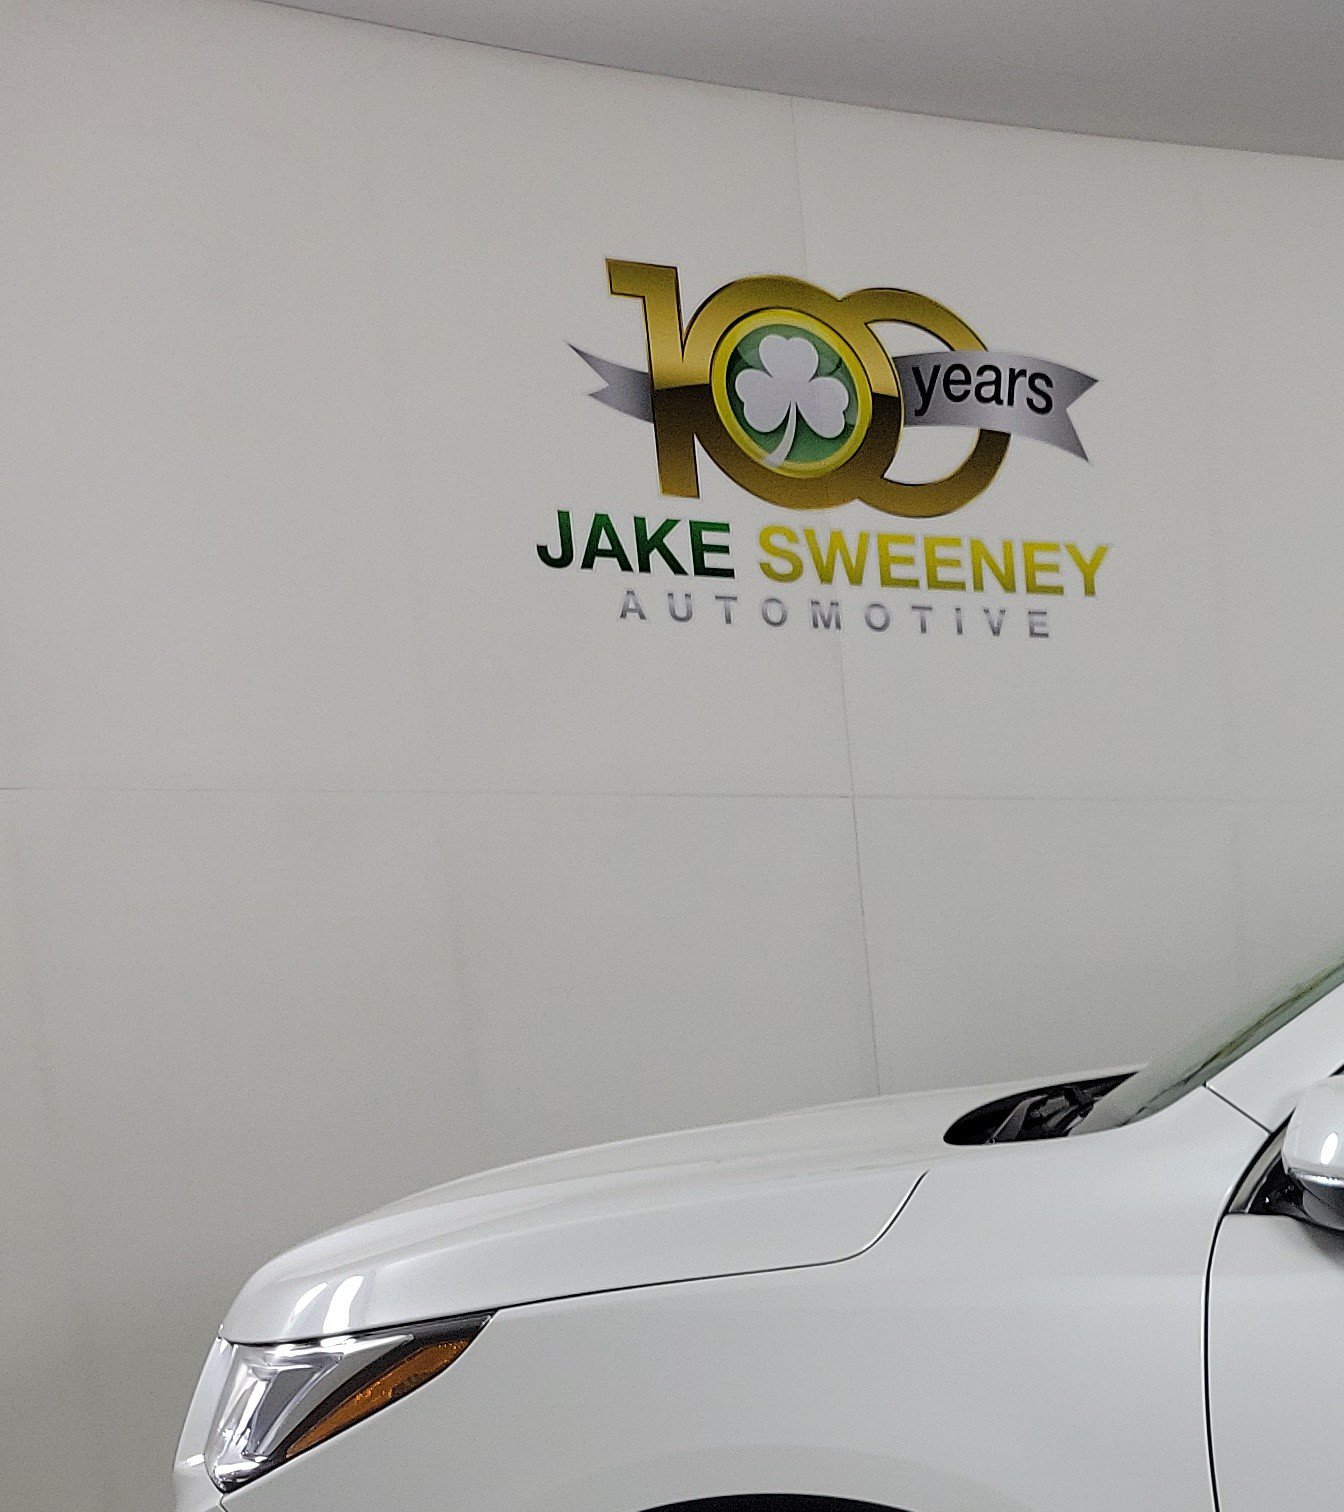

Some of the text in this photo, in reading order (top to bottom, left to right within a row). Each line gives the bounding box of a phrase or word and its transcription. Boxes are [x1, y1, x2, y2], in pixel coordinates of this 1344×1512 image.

[911, 363, 1054, 416] years
[536, 510, 1109, 597] JAKE SWEENEY
[619, 590, 1050, 638] AUTOMOTIVE
